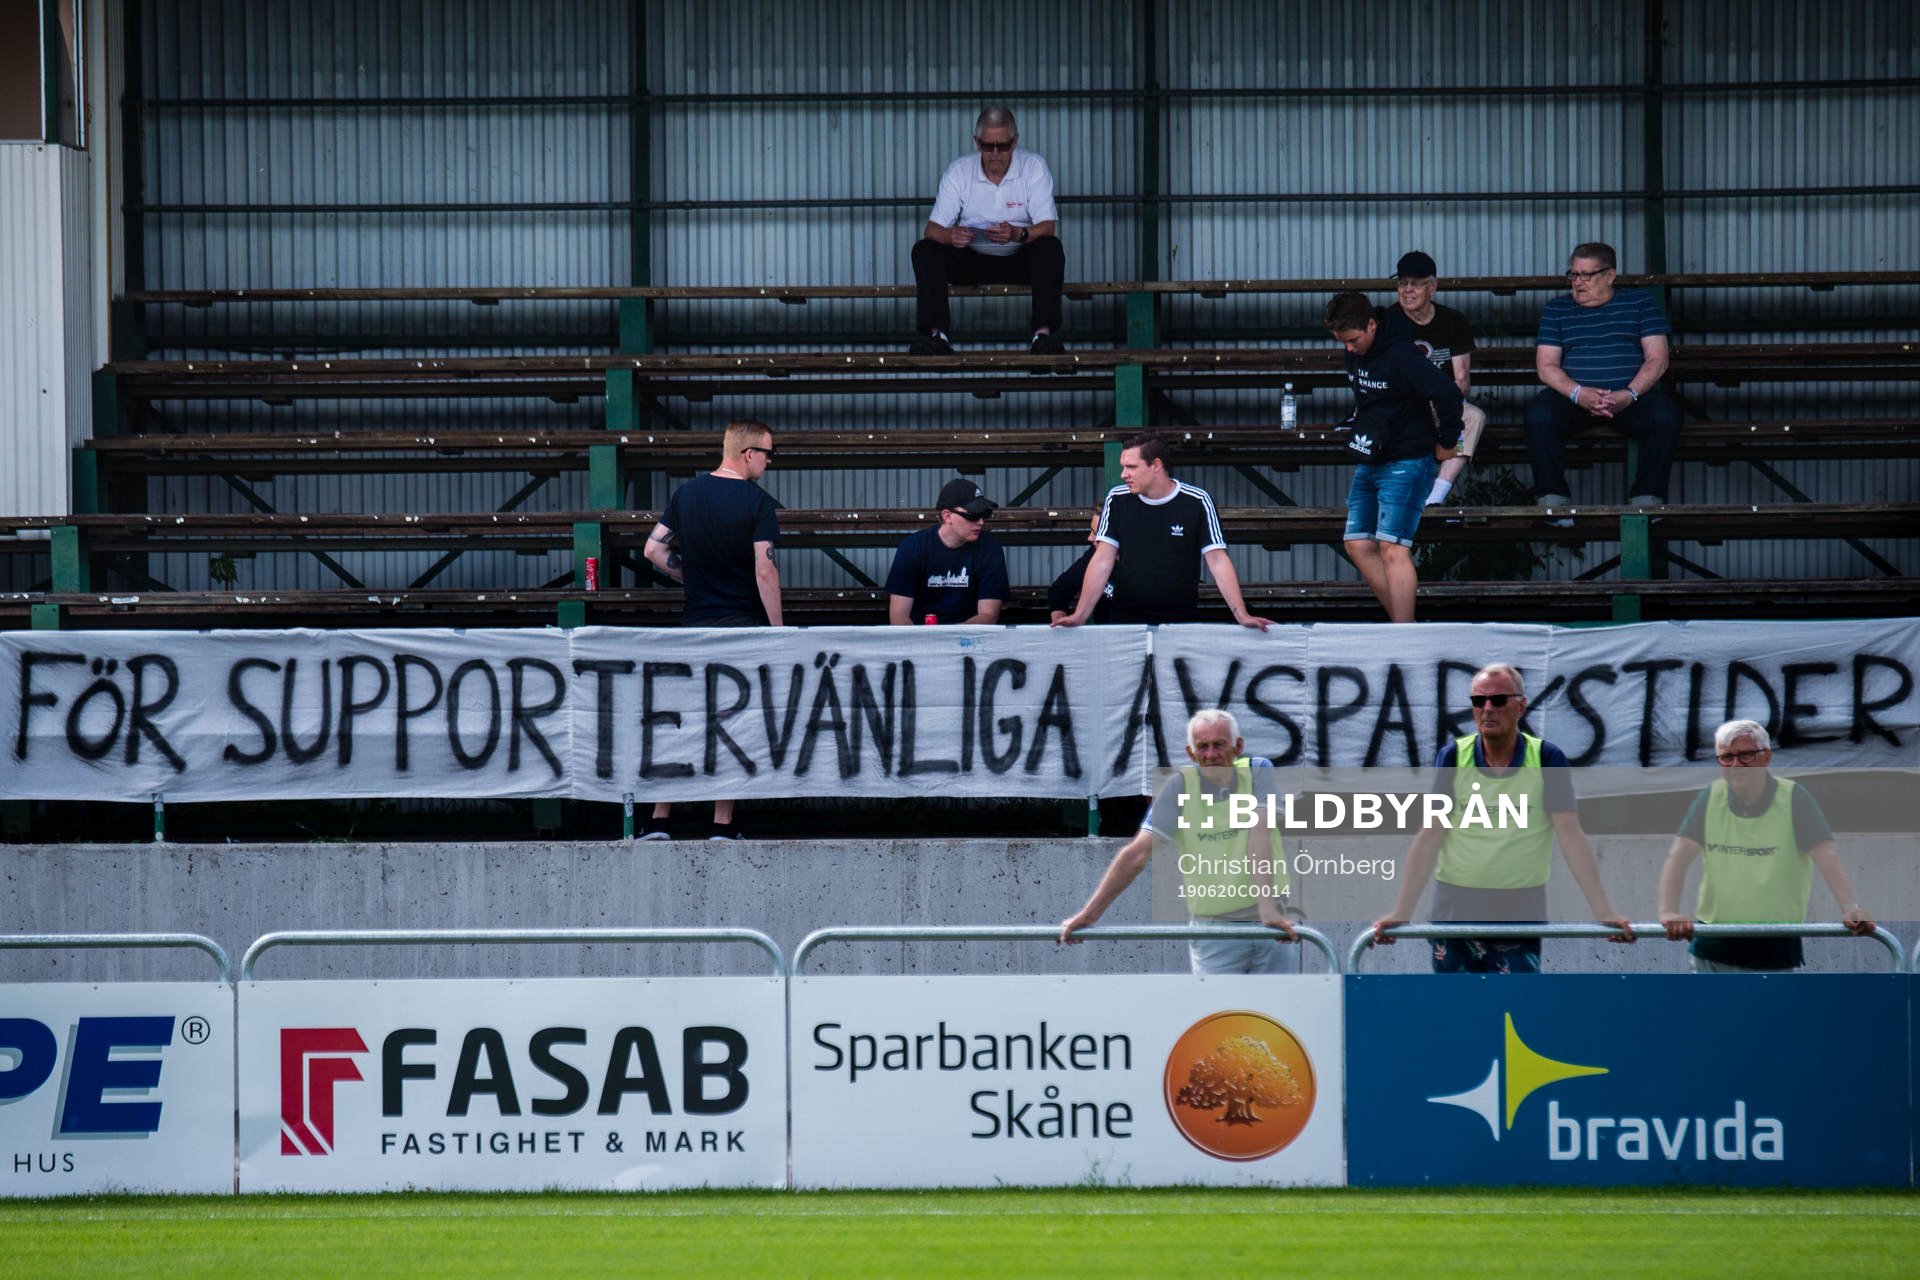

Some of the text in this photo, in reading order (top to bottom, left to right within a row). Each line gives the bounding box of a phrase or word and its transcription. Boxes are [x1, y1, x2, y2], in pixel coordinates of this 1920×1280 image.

[1349, 442, 1371, 455] adidas
[14, 650, 187, 773] FÖR
[222, 652, 1083, 780] SUPPORTERVÄNLIGA
[382, 1026, 749, 1117] FASAB
[813, 1022, 1132, 1083] Sparbanken
[970, 1085, 1133, 1138] Skåne
[1549, 1101, 1784, 1161] bravida
[14, 1153, 75, 1173] HUS
[381, 1131, 746, 1155] FASTIGHET & MARK
